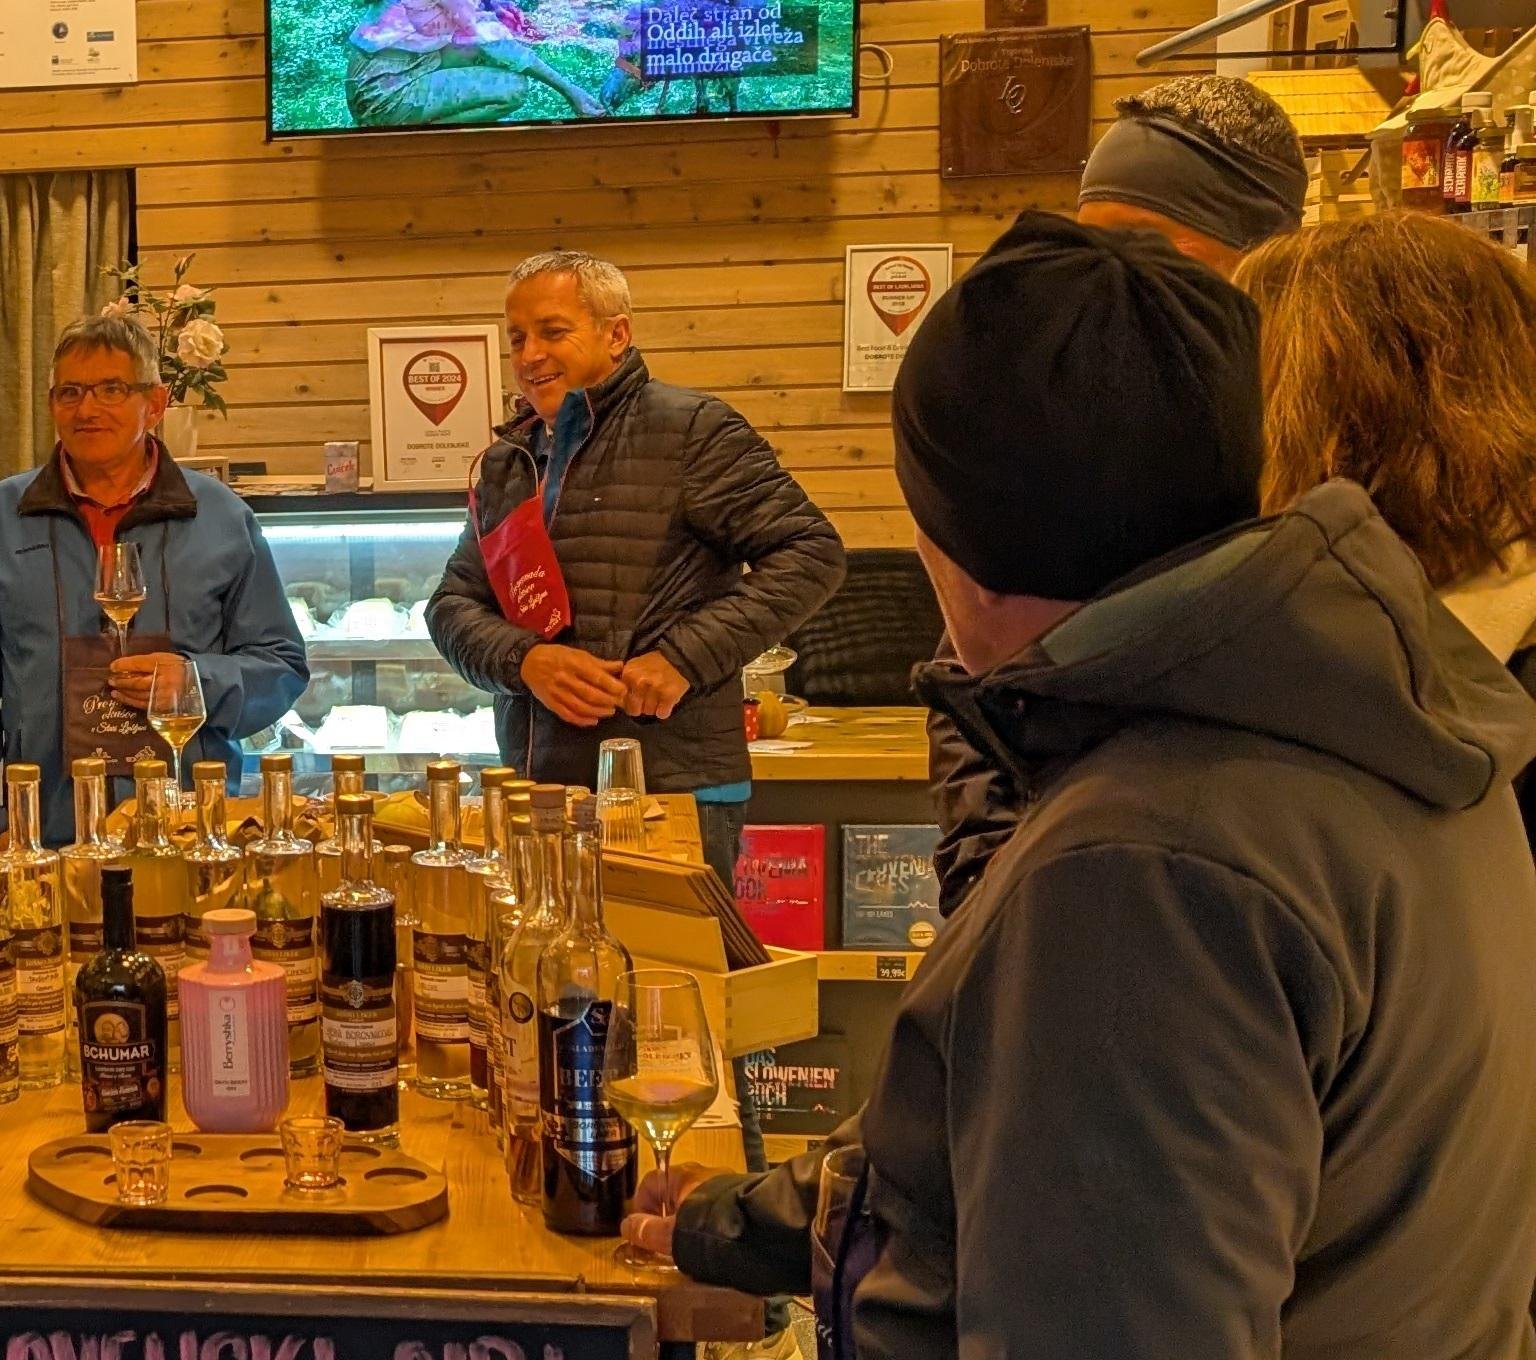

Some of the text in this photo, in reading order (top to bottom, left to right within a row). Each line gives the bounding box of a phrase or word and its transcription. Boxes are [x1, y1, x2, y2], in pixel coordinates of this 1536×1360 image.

[758, 0, 781, 20] od
[647, 19, 780, 41] Oddih ali izlet
[647, 48, 694, 67] malo
[408, 374, 462, 384] BEST OF 2024
